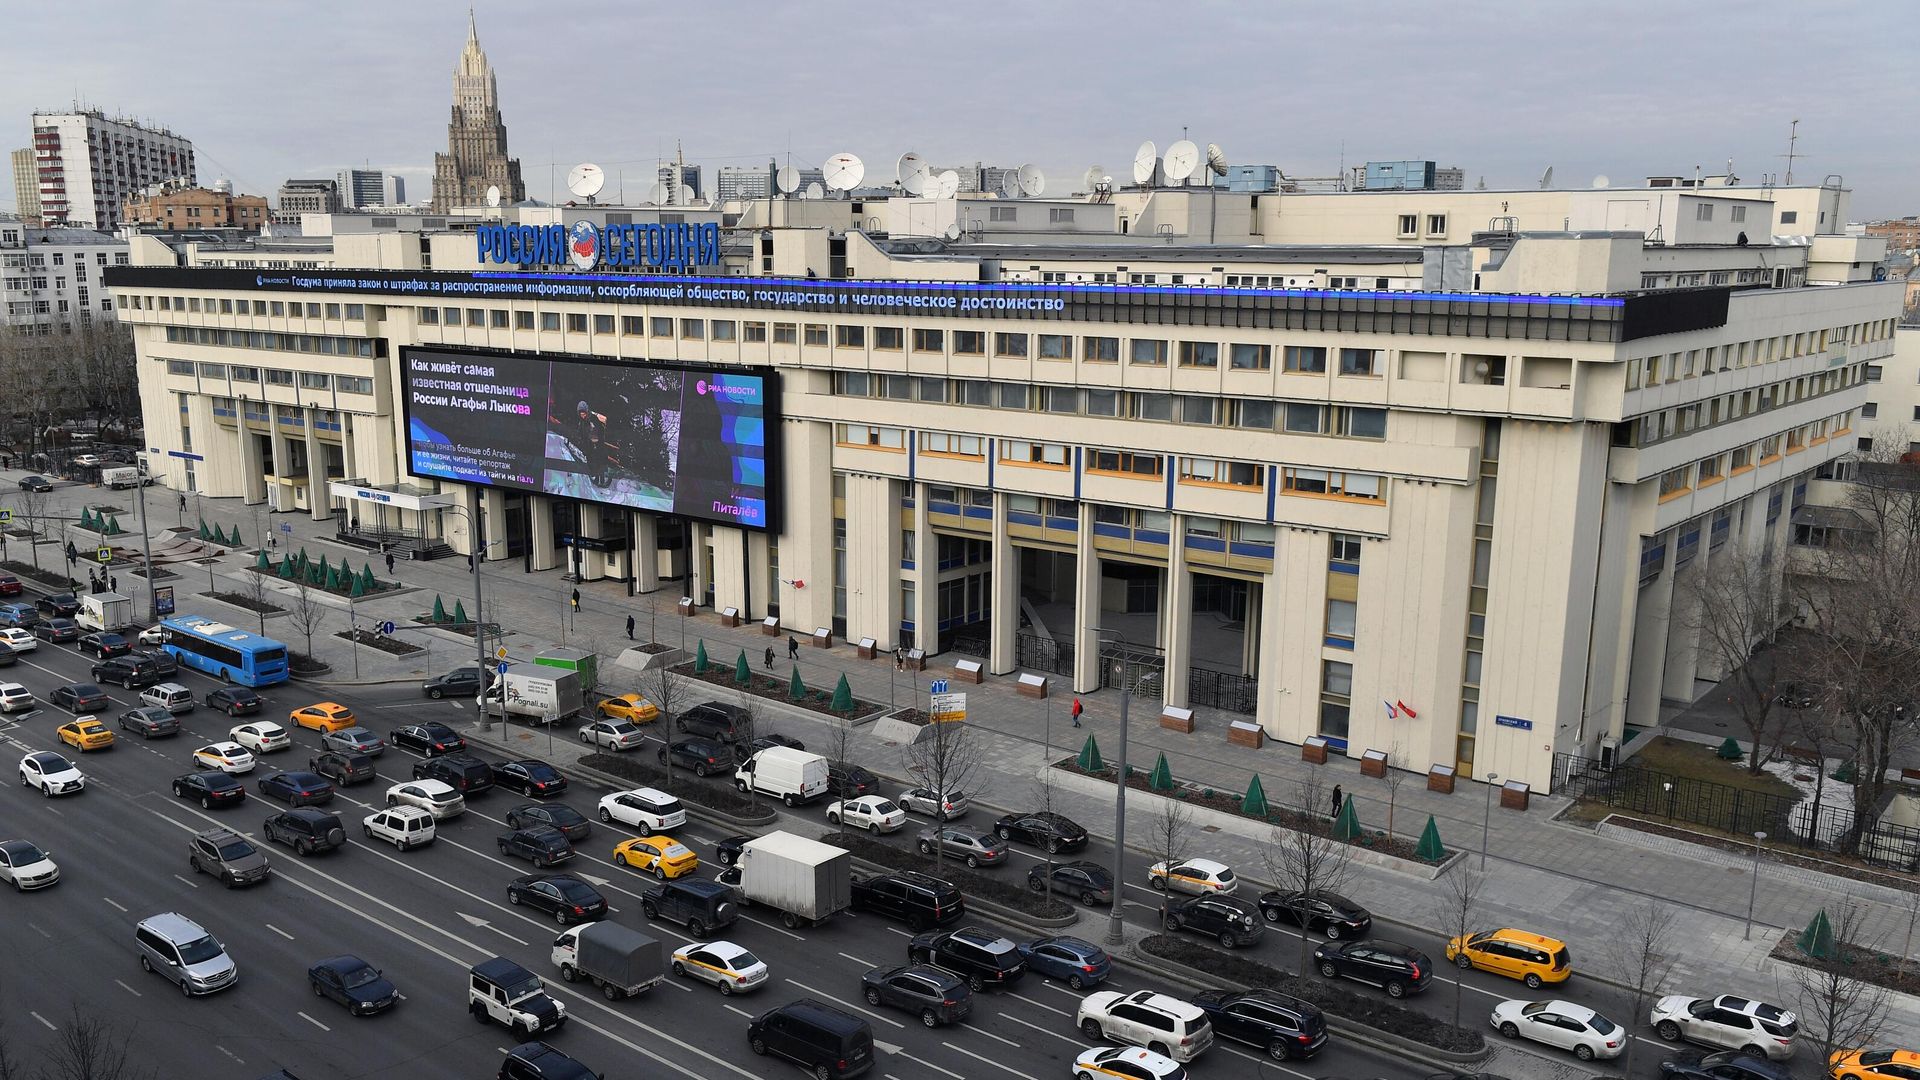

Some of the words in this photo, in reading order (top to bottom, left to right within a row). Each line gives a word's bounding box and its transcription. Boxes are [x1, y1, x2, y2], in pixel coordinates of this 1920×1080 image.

[476, 224, 566, 264] РОССИЯ
[604, 222, 721, 273] СЕГОДНЯ
[292, 276, 322, 288] Госдума
[324, 278, 356, 289] приняла
[358, 279, 381, 288] закон
[383, 280, 389, 288] о
[391, 279, 428, 292] штрафах
[430, 281, 440, 290] за
[443, 281, 524, 294] распространение
[526, 282, 595, 297] информации,
[598, 284, 684, 299] оскорбляющей
[687, 286, 750, 302] общество,
[754, 289, 835, 305] государство
[839, 294, 847, 304] и
[852, 293, 957, 309] человеческое
[960, 297, 1065, 311] достоинство
[411, 359, 429, 371] Как
[431, 361, 461, 374] живёт
[464, 364, 495, 377] самая
[412, 377, 462, 391] известная
[463, 382, 529, 398] отшельница
[708, 384, 722, 393] РИА
[723, 385, 756, 396] НОВОСТИ
[413, 392, 448, 406] России
[450, 396, 487, 411] Агафья
[489, 400, 531, 415] Лыкова
[457, 444, 481, 455] больше
[482, 447, 491, 456] об
[492, 449, 516, 460] Агафье
[453, 455, 477, 465] читайте
[479, 460, 511, 470] репортаж
[423, 461, 452, 471] слушайте
[453, 466, 478, 476] подкаст
[488, 471, 506, 480] тайги
[517, 475, 534, 484] ria.ru
[713, 501, 758, 518] Питалёв
[513, 696, 549, 709] Pognali.su
